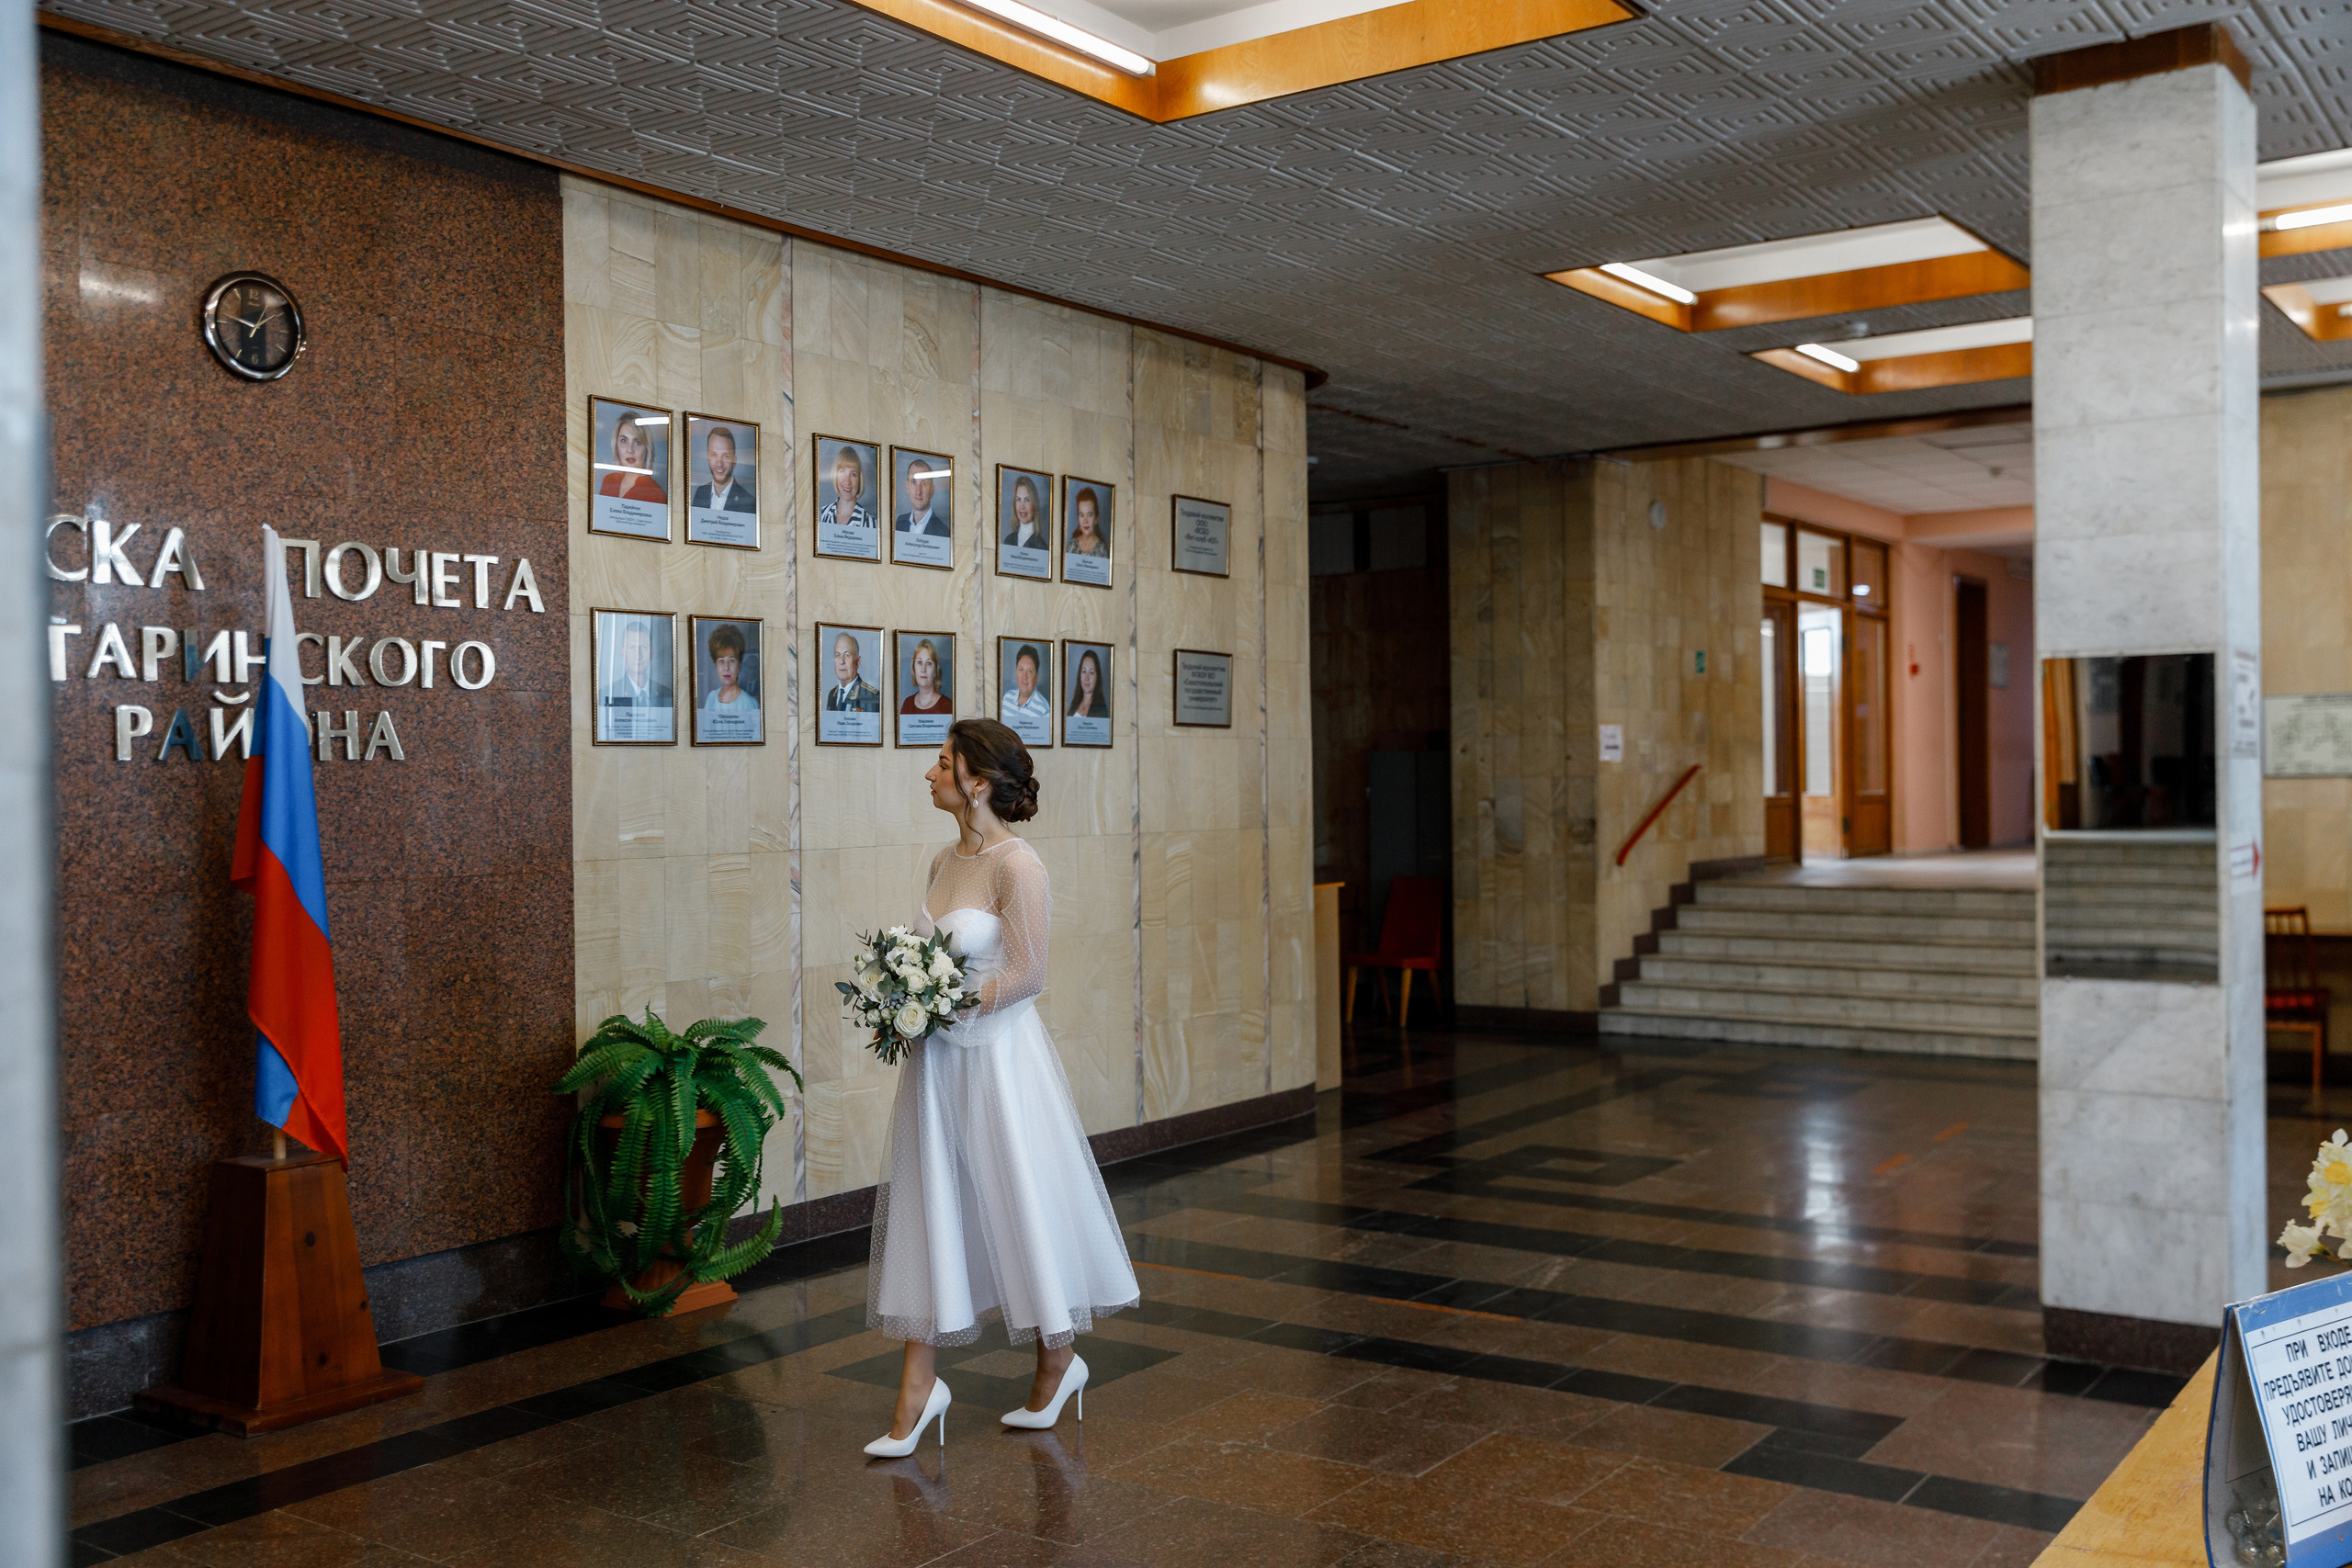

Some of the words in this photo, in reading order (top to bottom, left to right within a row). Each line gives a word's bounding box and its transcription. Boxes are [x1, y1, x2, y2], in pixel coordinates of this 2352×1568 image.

[248, 288, 259, 300] 12
[251, 353, 259, 365] 6
[277, 536, 546, 613] ПОЧЕТА
[116, 690, 405, 761] РАЙНА
[2285, 1338, 2309, 1363] ПРИ
[2316, 1325, 2352, 1353] ВХОДЕ
[2263, 1361, 2335, 1402] ПРЕДЪЯВИТЕ
[2336, 1354, 2352, 1381] ДО
[2281, 1384, 2352, 1427] УДОСТОВЕРЯ
[2295, 1424, 2327, 1453] ВАШУ
[2306, 1459, 2318, 1480] И
[2317, 1484, 2336, 1508] НА
